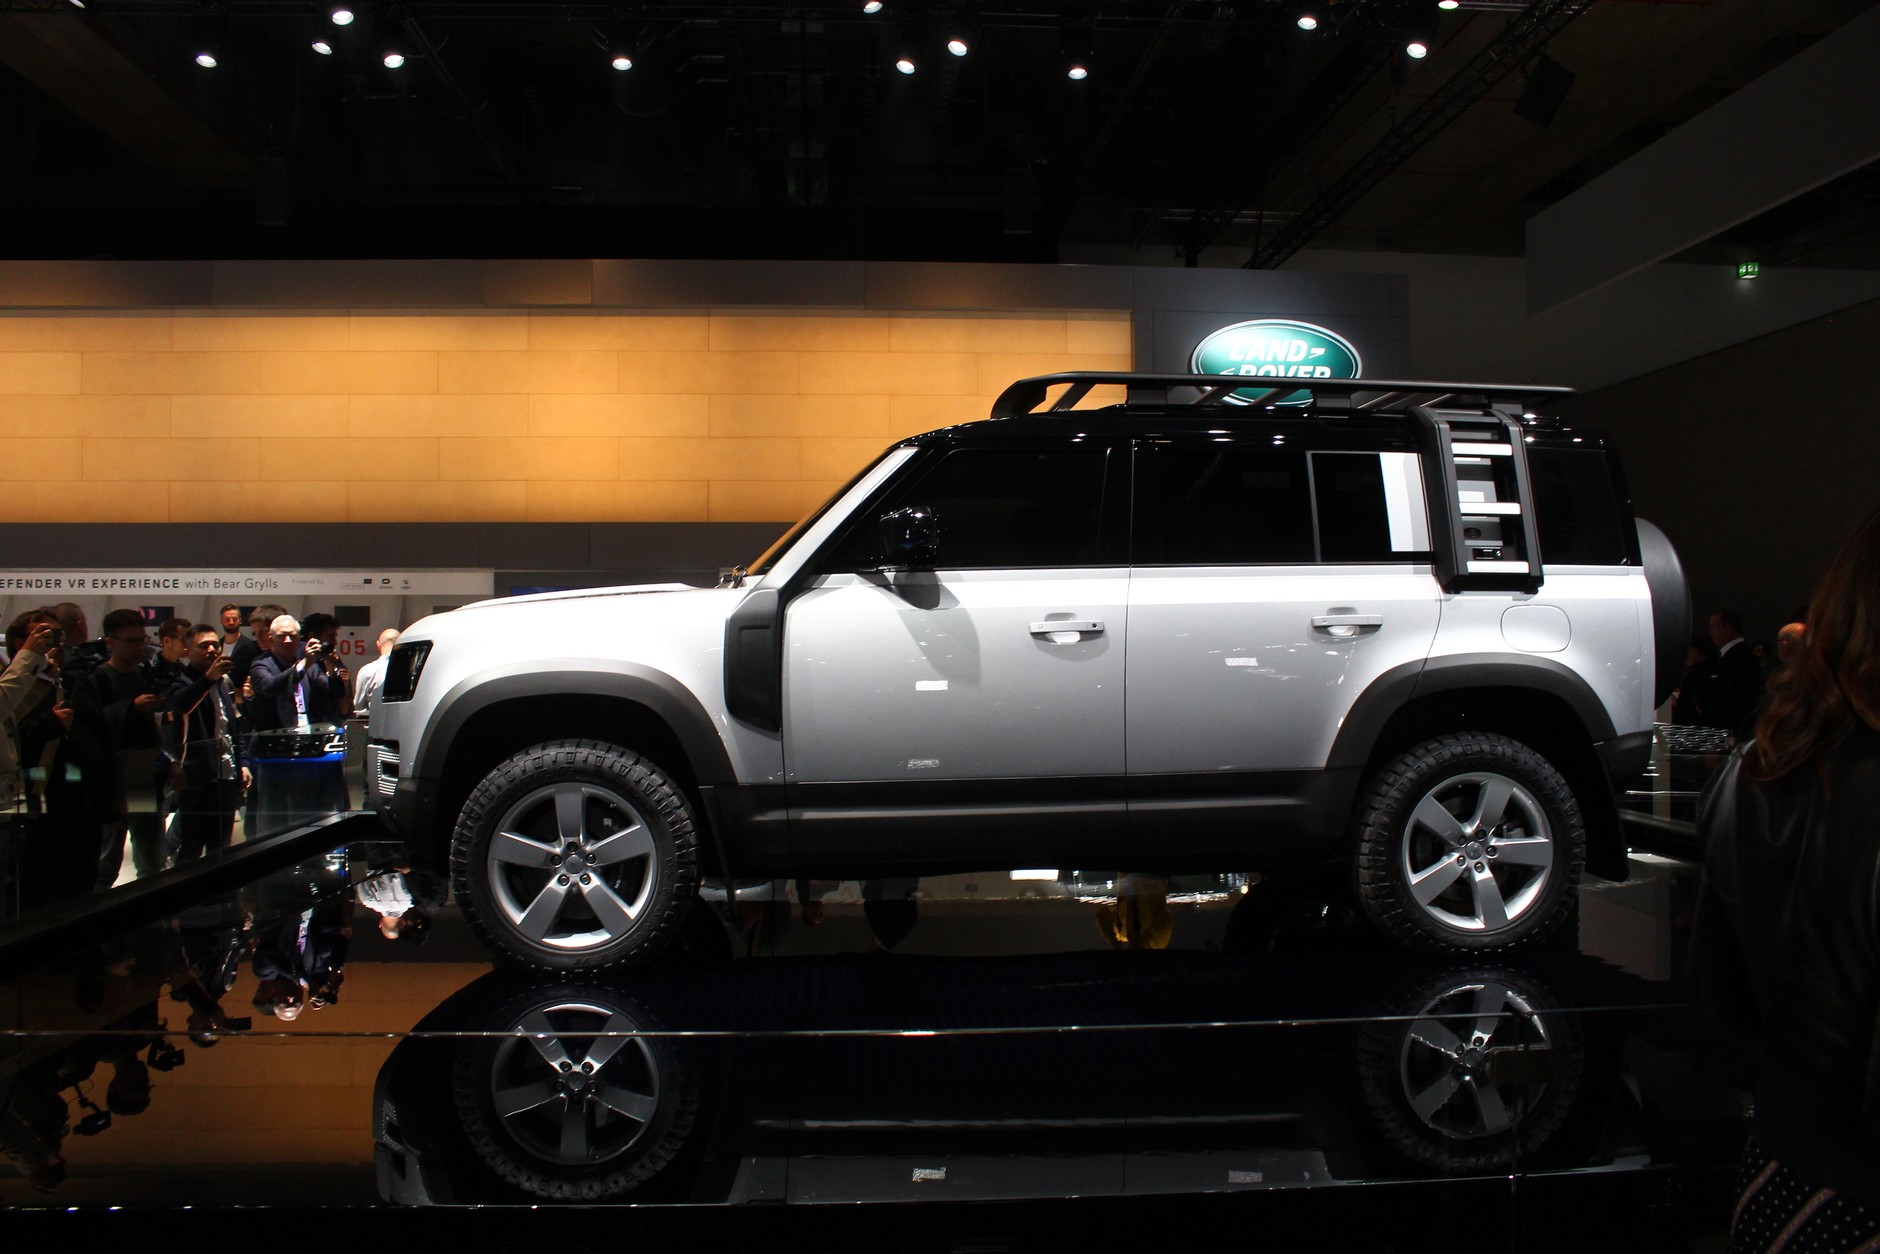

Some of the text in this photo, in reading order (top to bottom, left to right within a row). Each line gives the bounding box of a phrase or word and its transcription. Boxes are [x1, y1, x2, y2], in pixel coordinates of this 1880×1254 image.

[1229, 339, 1308, 362] LAND
[0, 578, 278, 591] EFENDER VR EXPERIENCE with Bear Grylls
[340, 639, 366, 656] 05
